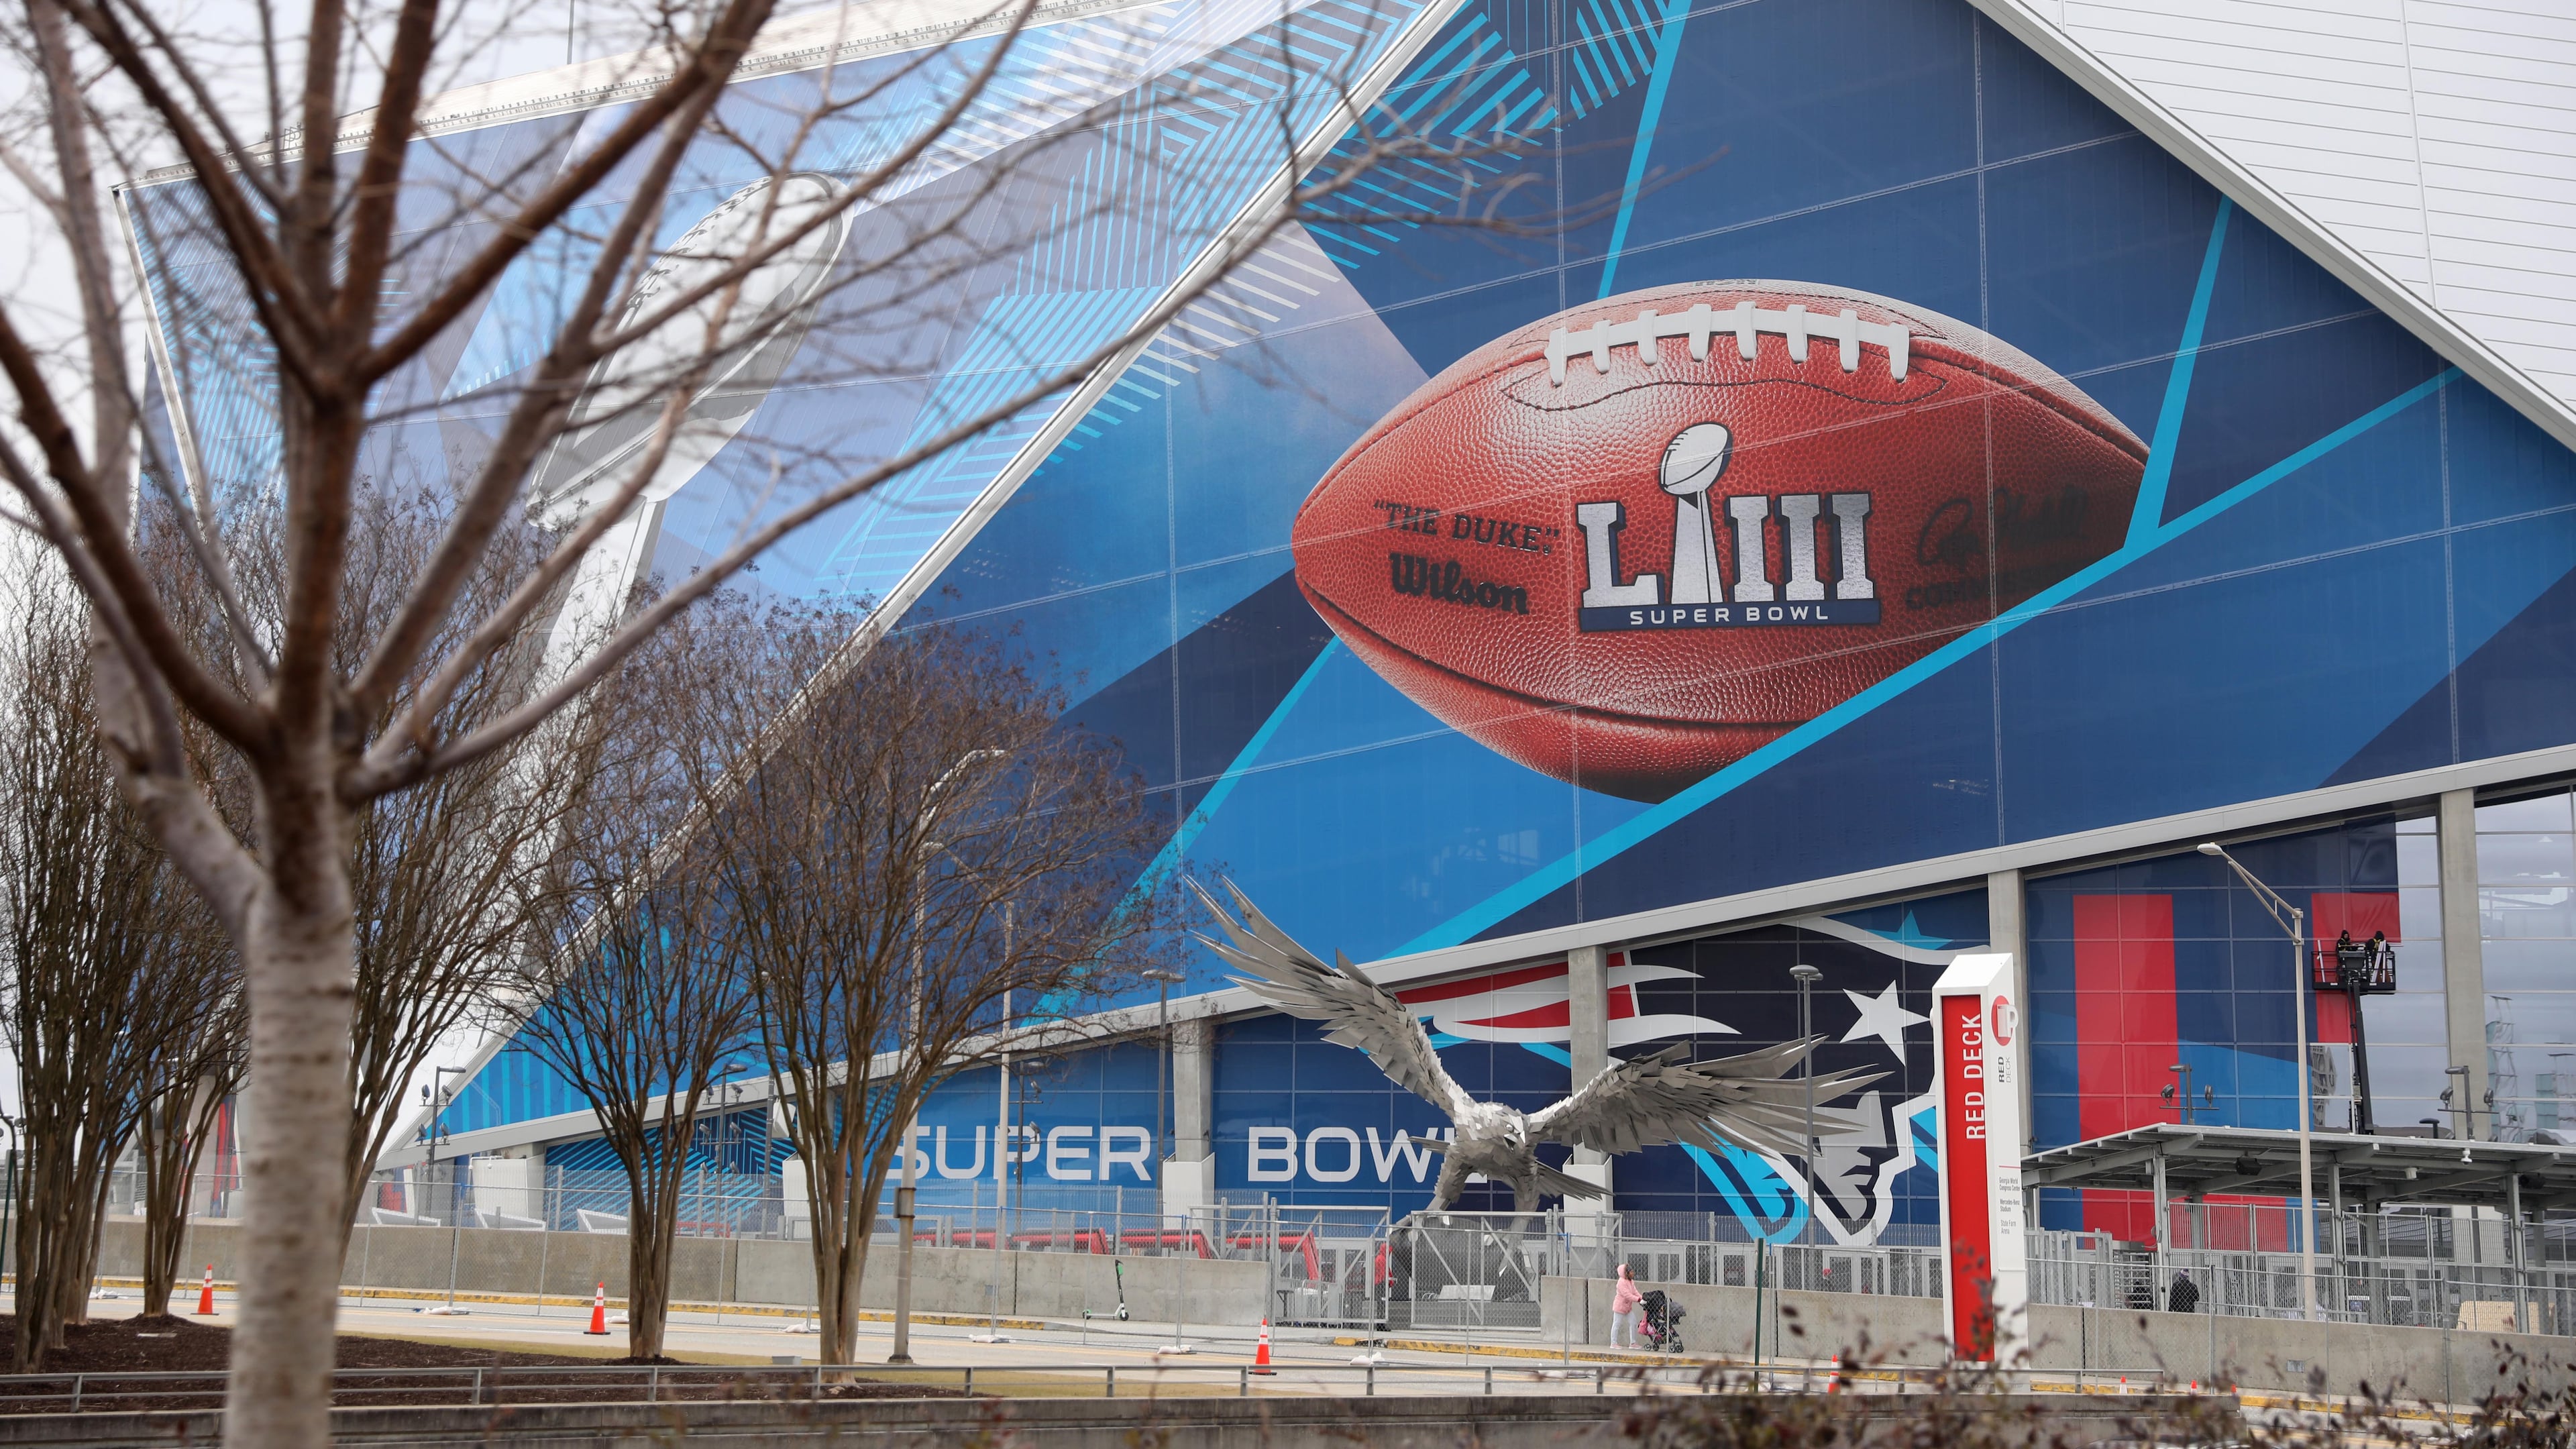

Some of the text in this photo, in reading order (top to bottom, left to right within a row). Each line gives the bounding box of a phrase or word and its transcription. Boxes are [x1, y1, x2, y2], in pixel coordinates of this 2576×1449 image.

[1389, 552, 1529, 615] Wilson
[1629, 606, 1829, 625] SUPER BOWL
[1962, 1014, 1986, 1139] RED DECK
[885, 1126, 1152, 1181] SUPER
[1999, 1184, 2011, 1192] Congress
